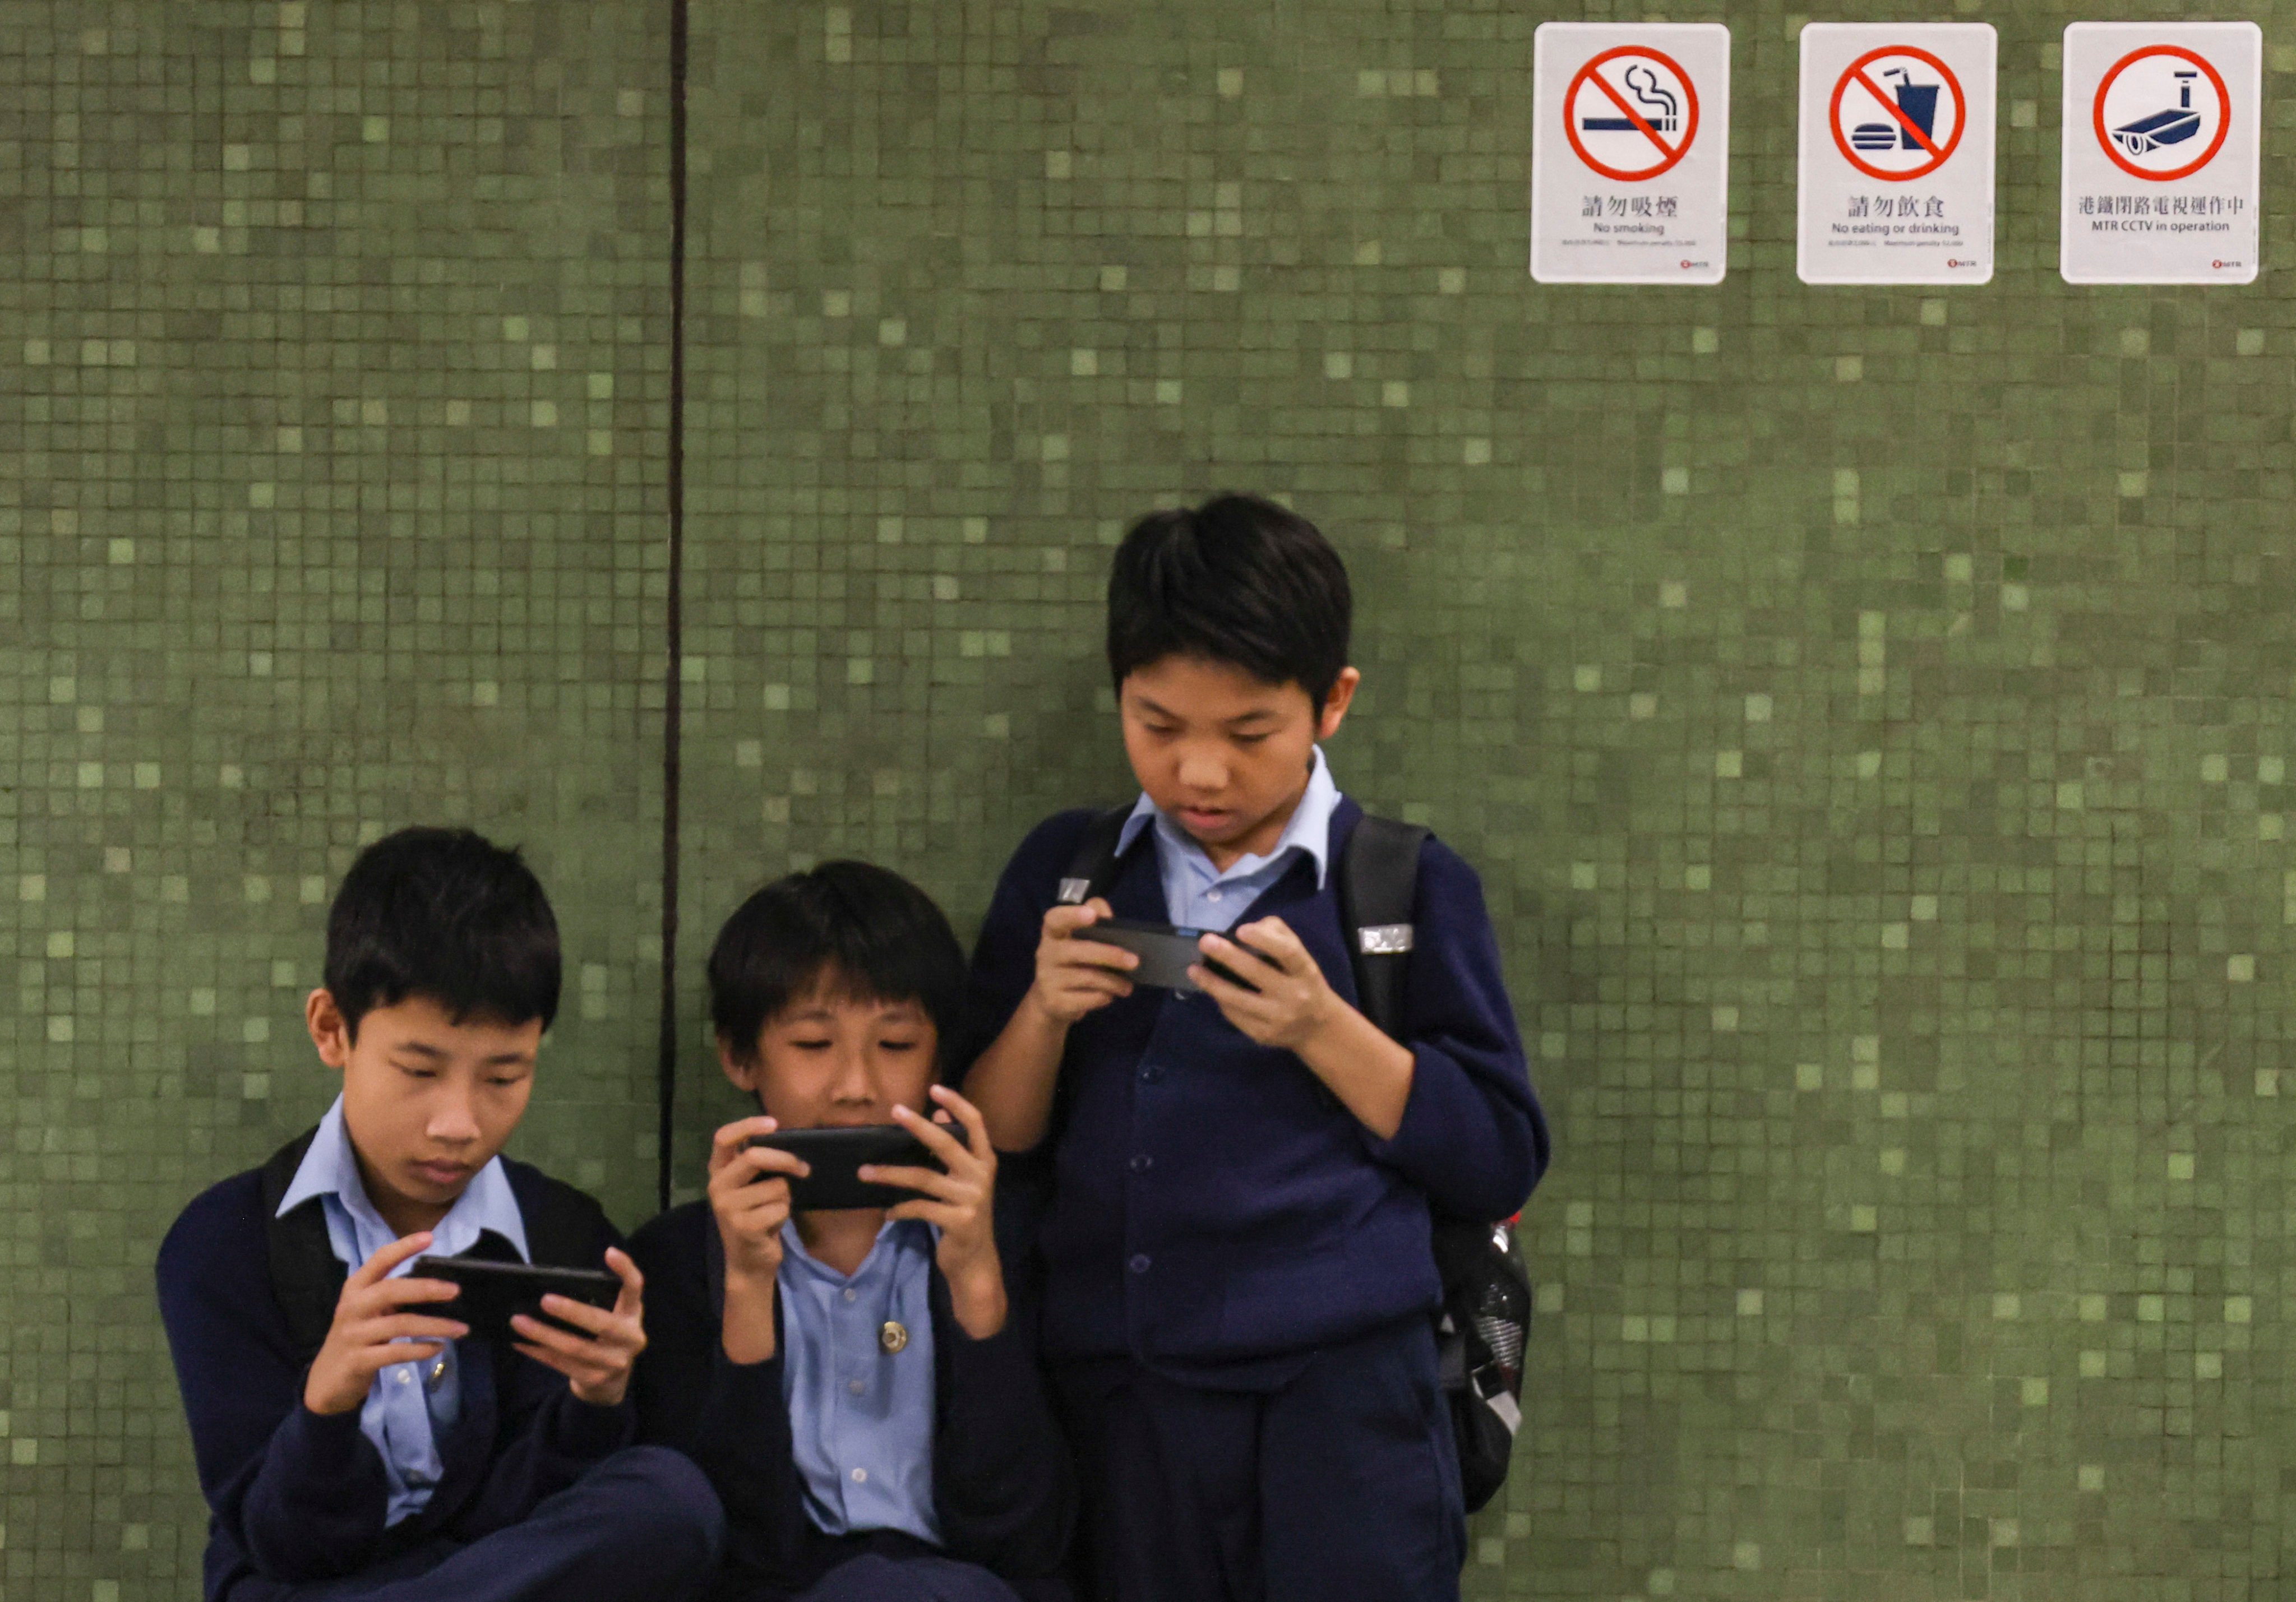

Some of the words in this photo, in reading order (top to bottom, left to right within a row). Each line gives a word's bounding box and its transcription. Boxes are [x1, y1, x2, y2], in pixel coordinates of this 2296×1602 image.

[1582, 195, 1678, 217] 請勿吸煙
[1848, 195, 1944, 218] 請勿飲食
[2078, 195, 2243, 215] 港鐵閉路電視運作中
[1593, 223, 1610, 233] No
[1613, 223, 1665, 236] smoking
[1832, 223, 1849, 234] No
[1851, 223, 1890, 236] eating
[1892, 225, 1906, 234] or
[1908, 223, 1960, 236] drinking
[2091, 220, 2118, 231] MTR
[2121, 220, 2153, 231] CCTV
[2156, 220, 2168, 231] in
[2170, 220, 2230, 234] operation
